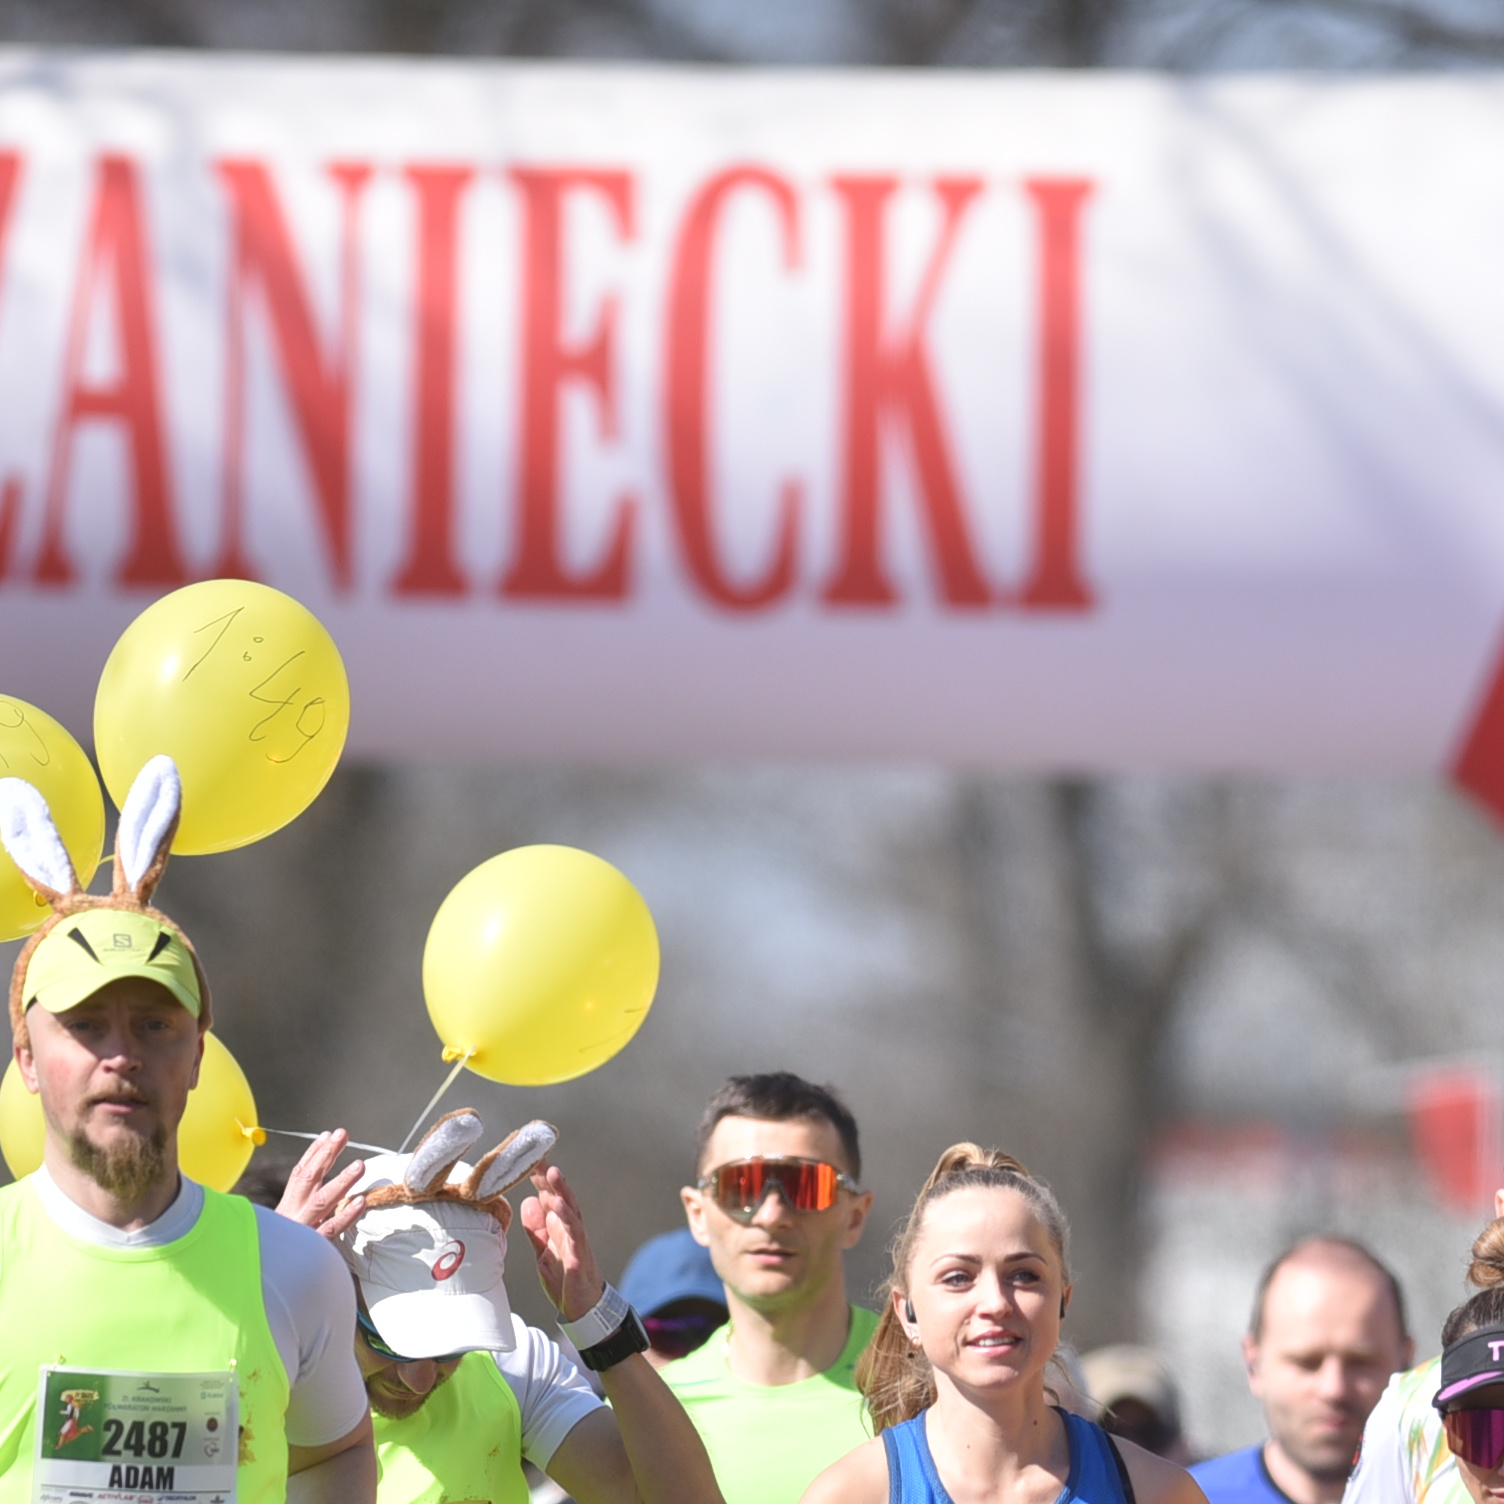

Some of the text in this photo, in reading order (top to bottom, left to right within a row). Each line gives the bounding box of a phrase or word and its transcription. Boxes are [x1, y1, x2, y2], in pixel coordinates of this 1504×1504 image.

[182, 607, 325, 764] 1:49
[101, 1418, 187, 1459] 2487
[108, 1465, 175, 1490] ADAM
